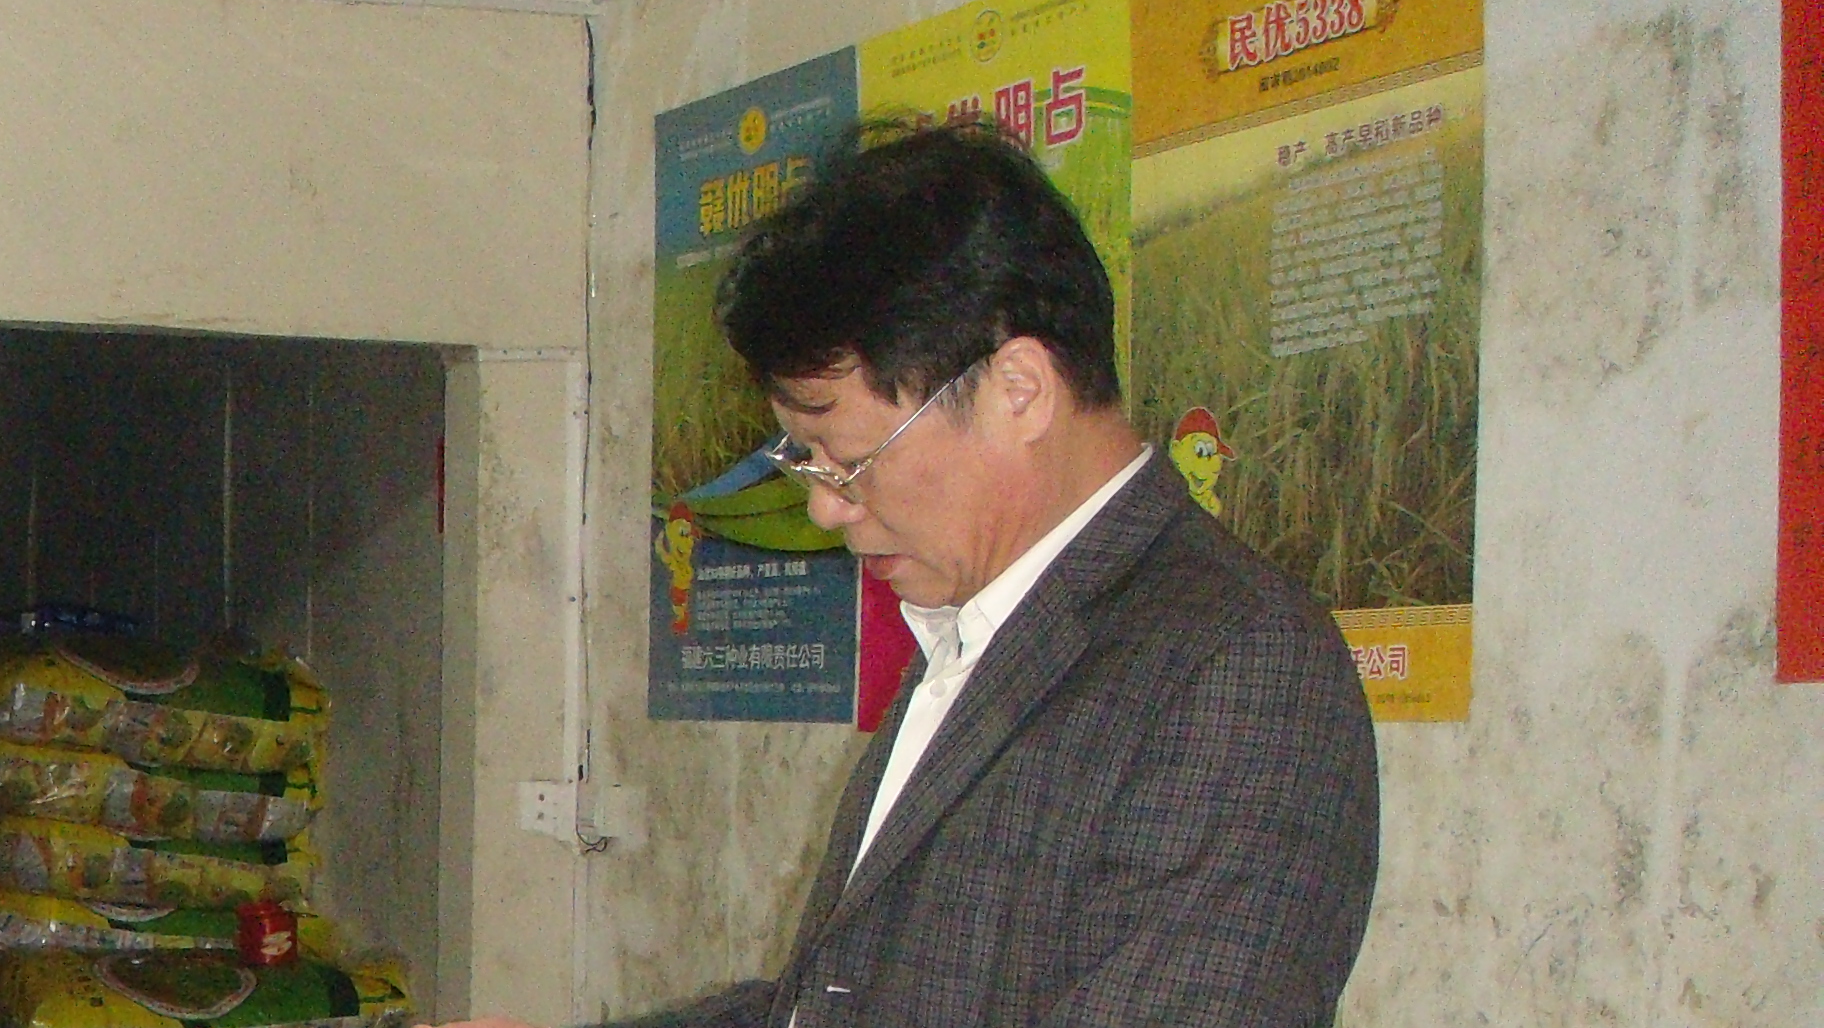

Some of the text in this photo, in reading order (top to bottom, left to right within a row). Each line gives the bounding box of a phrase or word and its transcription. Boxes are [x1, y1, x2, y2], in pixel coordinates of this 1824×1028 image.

[1228, 0, 1365, 69] 民优5338
[681, 643, 825, 670] 福建六三种业有限责任公司
